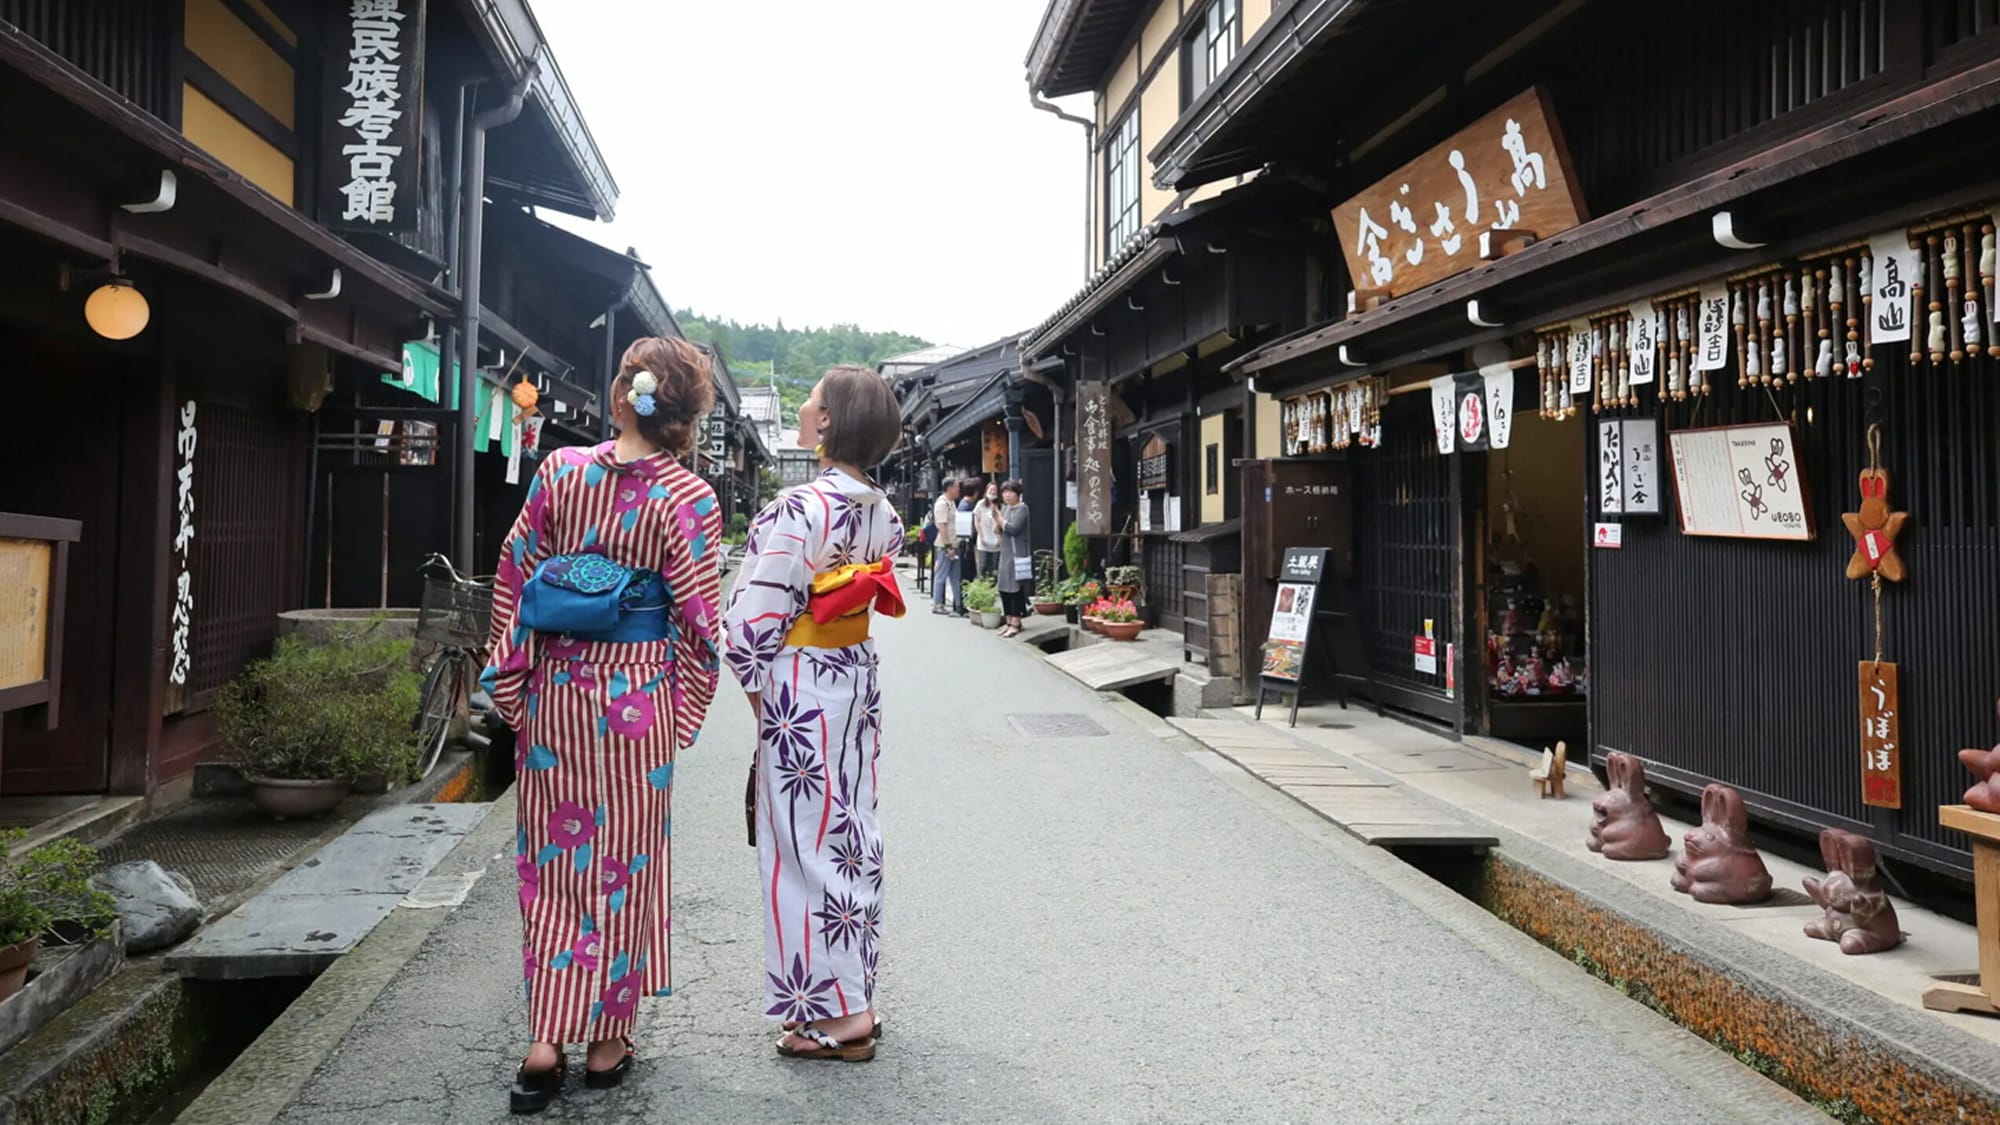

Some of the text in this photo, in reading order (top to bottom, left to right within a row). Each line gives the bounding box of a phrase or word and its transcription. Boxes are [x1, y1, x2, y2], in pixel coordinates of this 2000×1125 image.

[1878, 255, 1906, 332] 高山
[1633, 317, 1651, 376] 高山
[1866, 678, 1895, 773] うぼぼ
